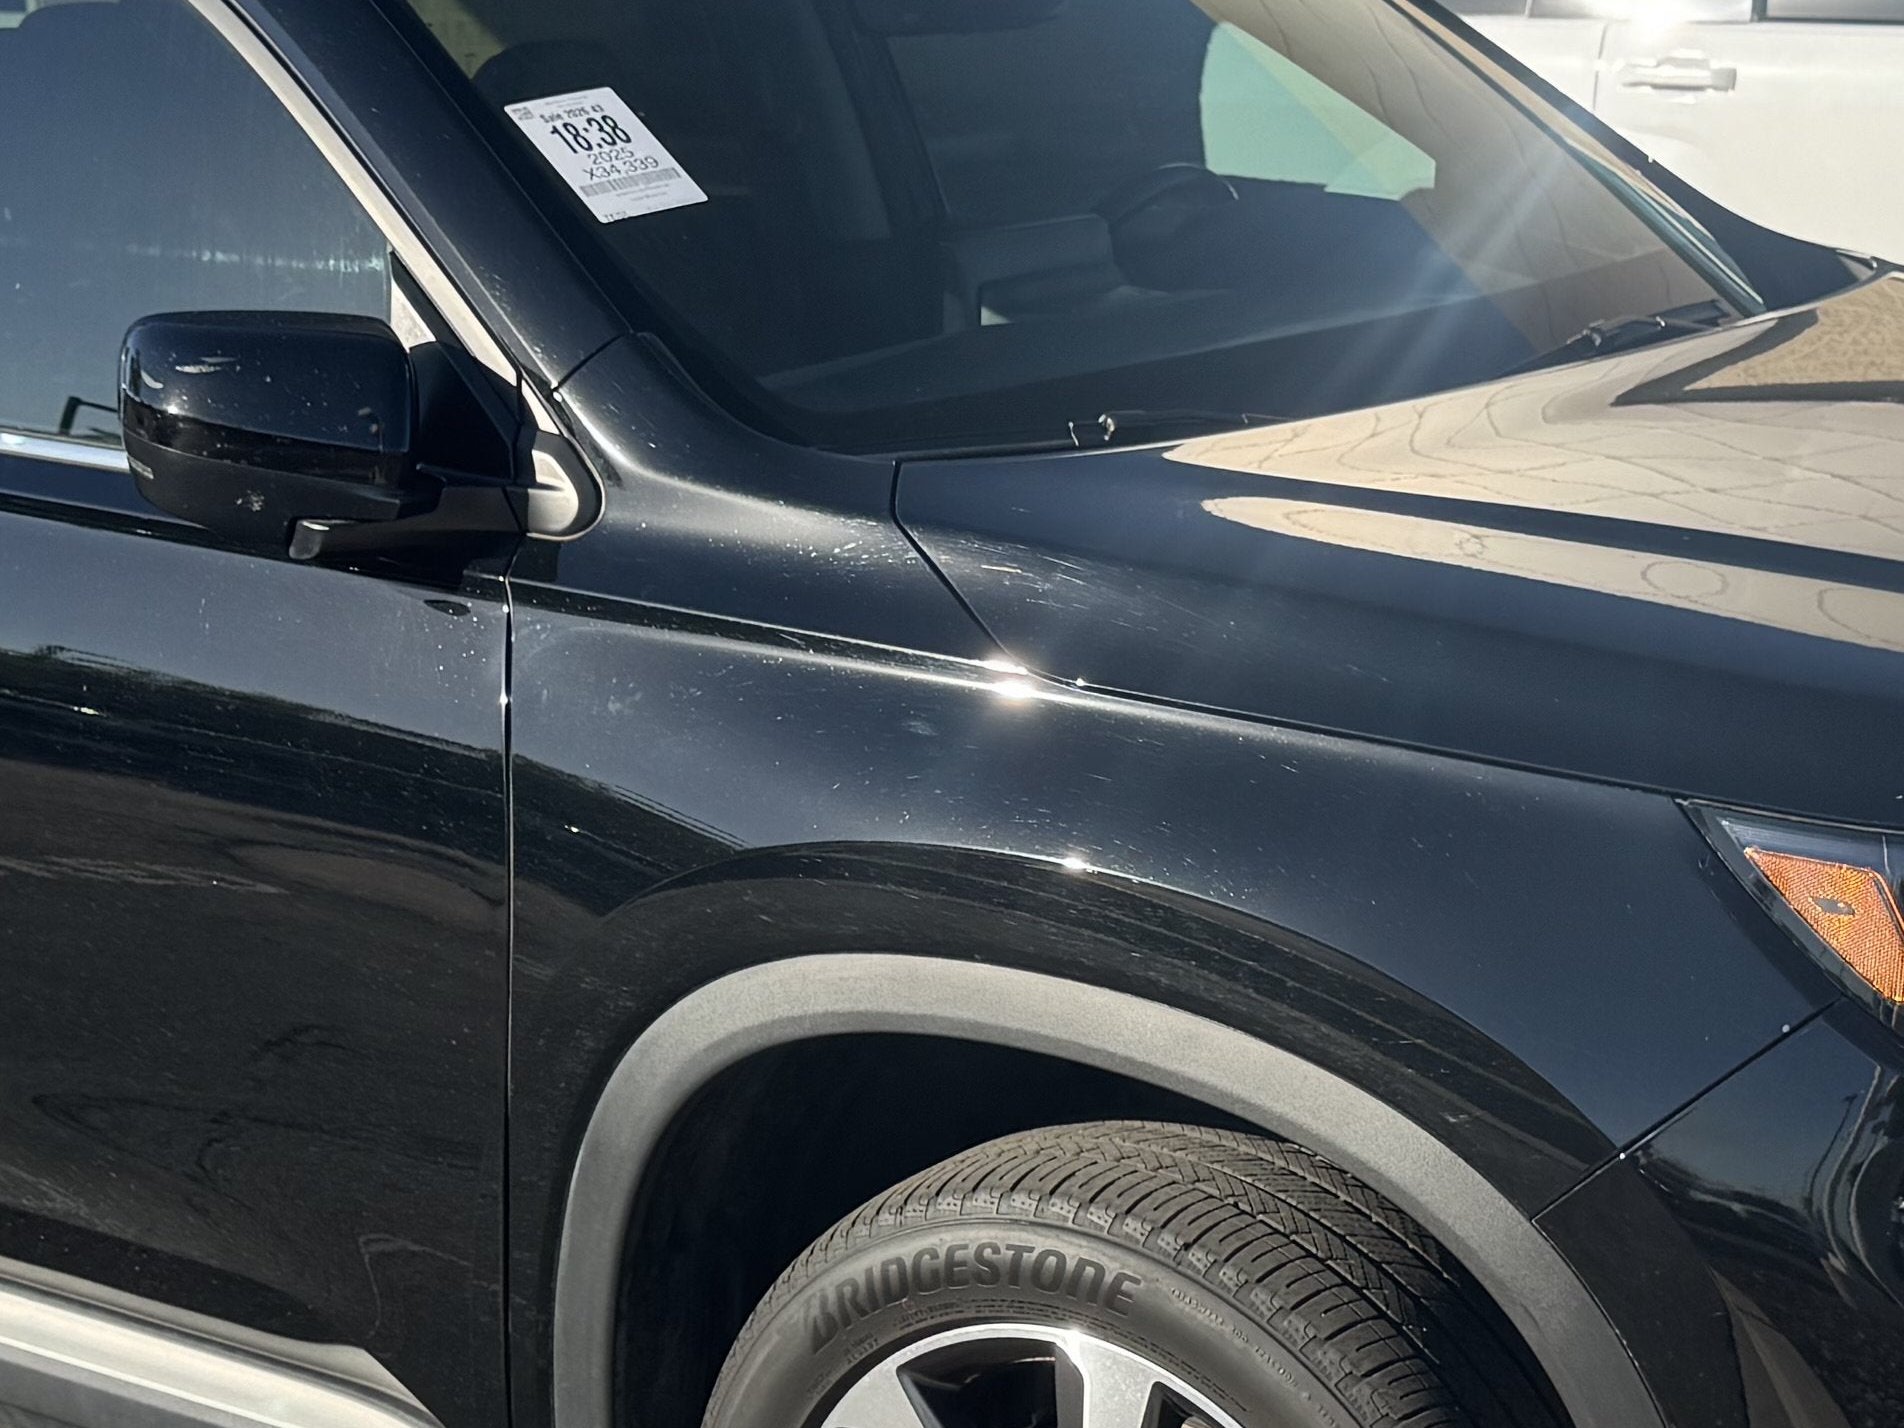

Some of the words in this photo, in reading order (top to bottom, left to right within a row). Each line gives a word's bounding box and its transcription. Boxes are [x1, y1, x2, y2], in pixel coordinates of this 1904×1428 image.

[550, 114, 632, 154] 18:38
[587, 147, 634, 166] 2025
[809, 1241, 1143, 1355] BRIDGESTONE
